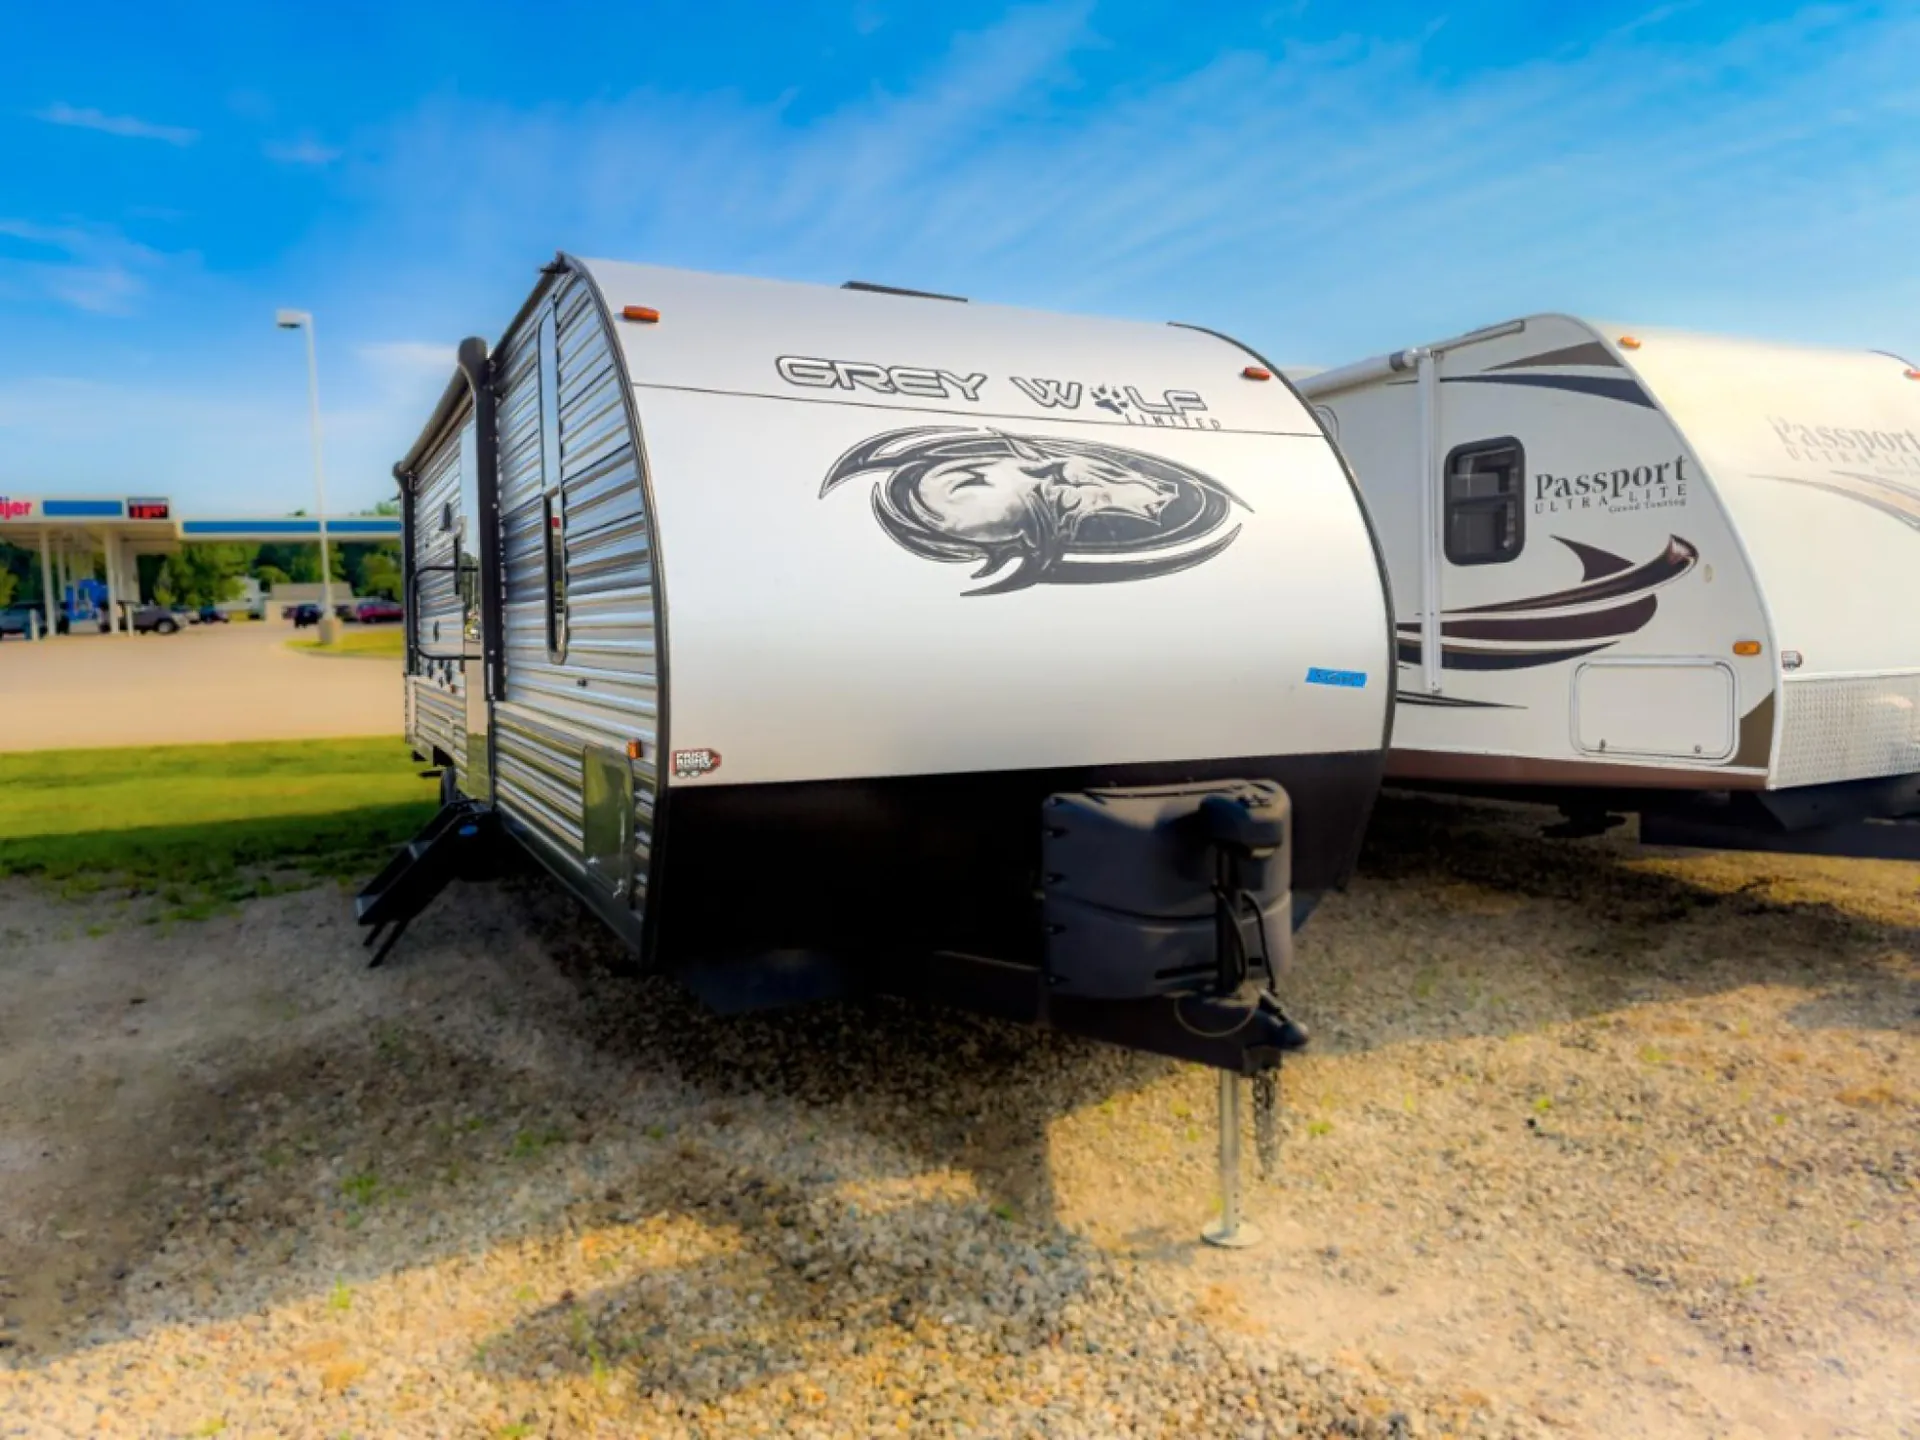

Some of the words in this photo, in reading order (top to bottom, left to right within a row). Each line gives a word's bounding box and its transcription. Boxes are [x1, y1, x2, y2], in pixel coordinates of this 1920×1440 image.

[775, 355, 988, 401] GREY
[1124, 412, 1221, 431] LIMITED
[1534, 454, 1688, 499] Passport
[1534, 495, 1608, 515] ULTRA
[1628, 483, 1687, 503] LITE
